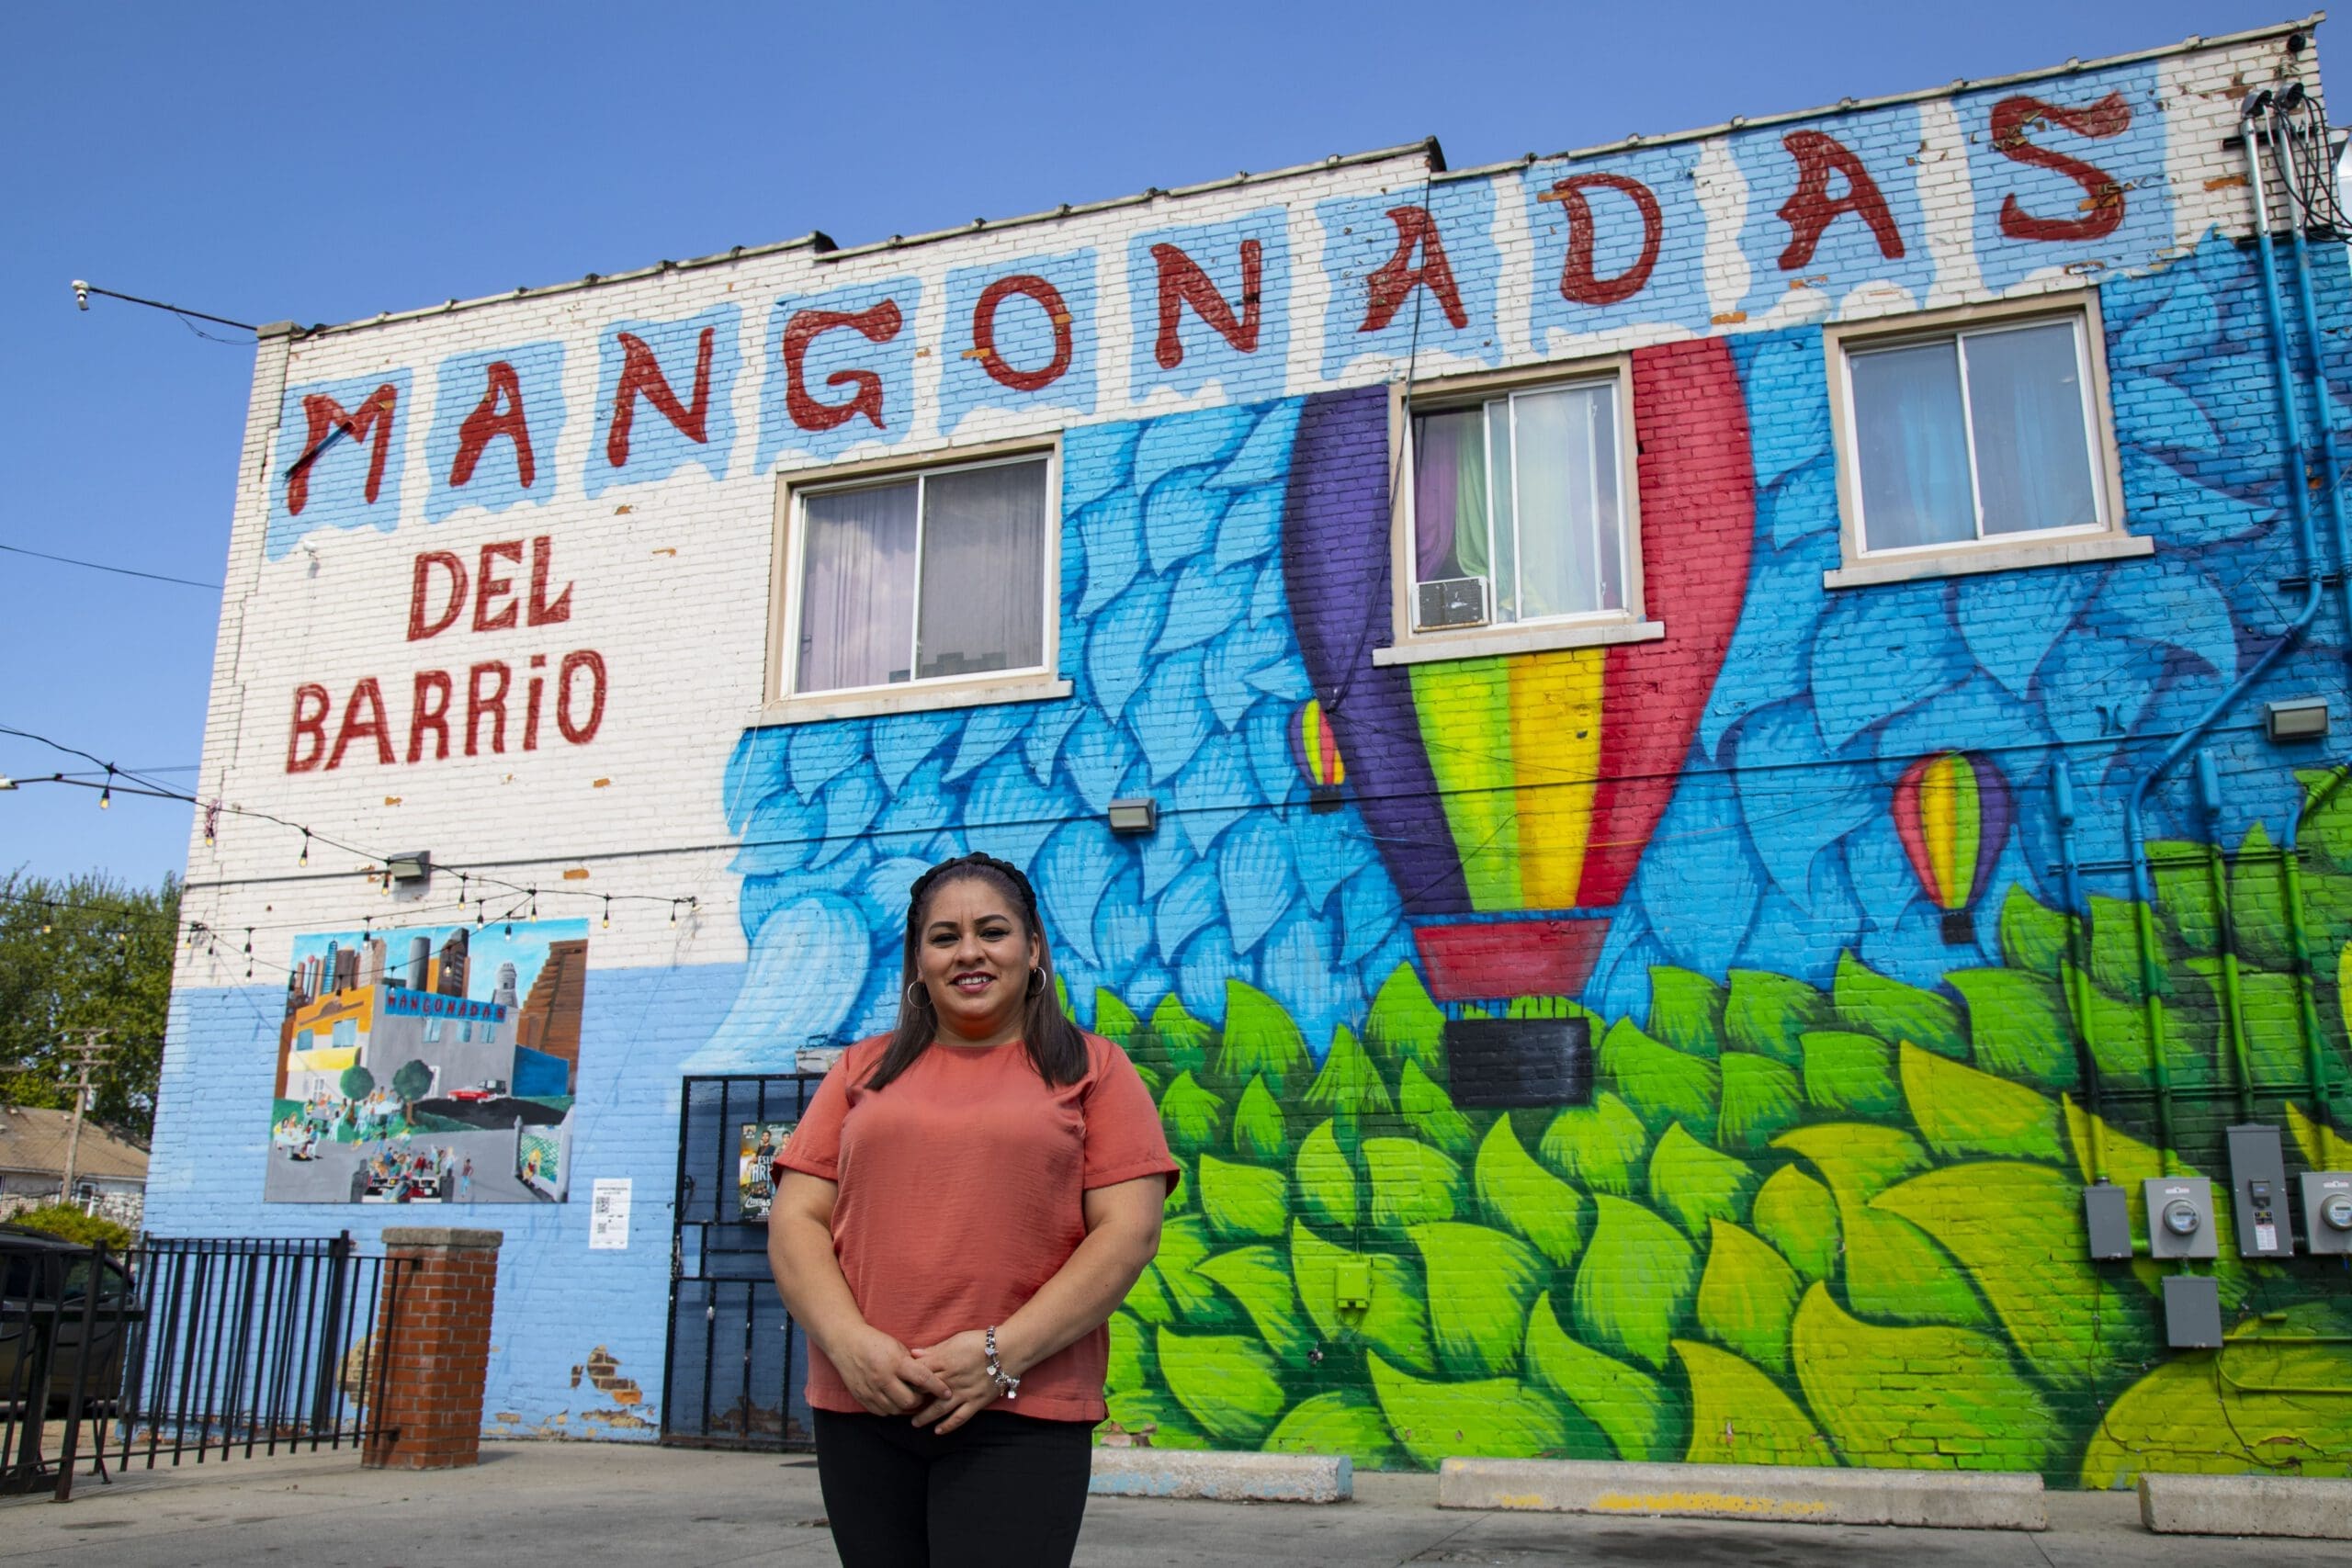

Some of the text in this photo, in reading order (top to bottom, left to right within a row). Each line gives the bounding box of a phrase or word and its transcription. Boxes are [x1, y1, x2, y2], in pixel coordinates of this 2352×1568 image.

[288, 90, 2132, 516] MANGONADAS
[407, 536, 573, 641] DEL
[387, 994, 506, 1019] MANGONADAS
